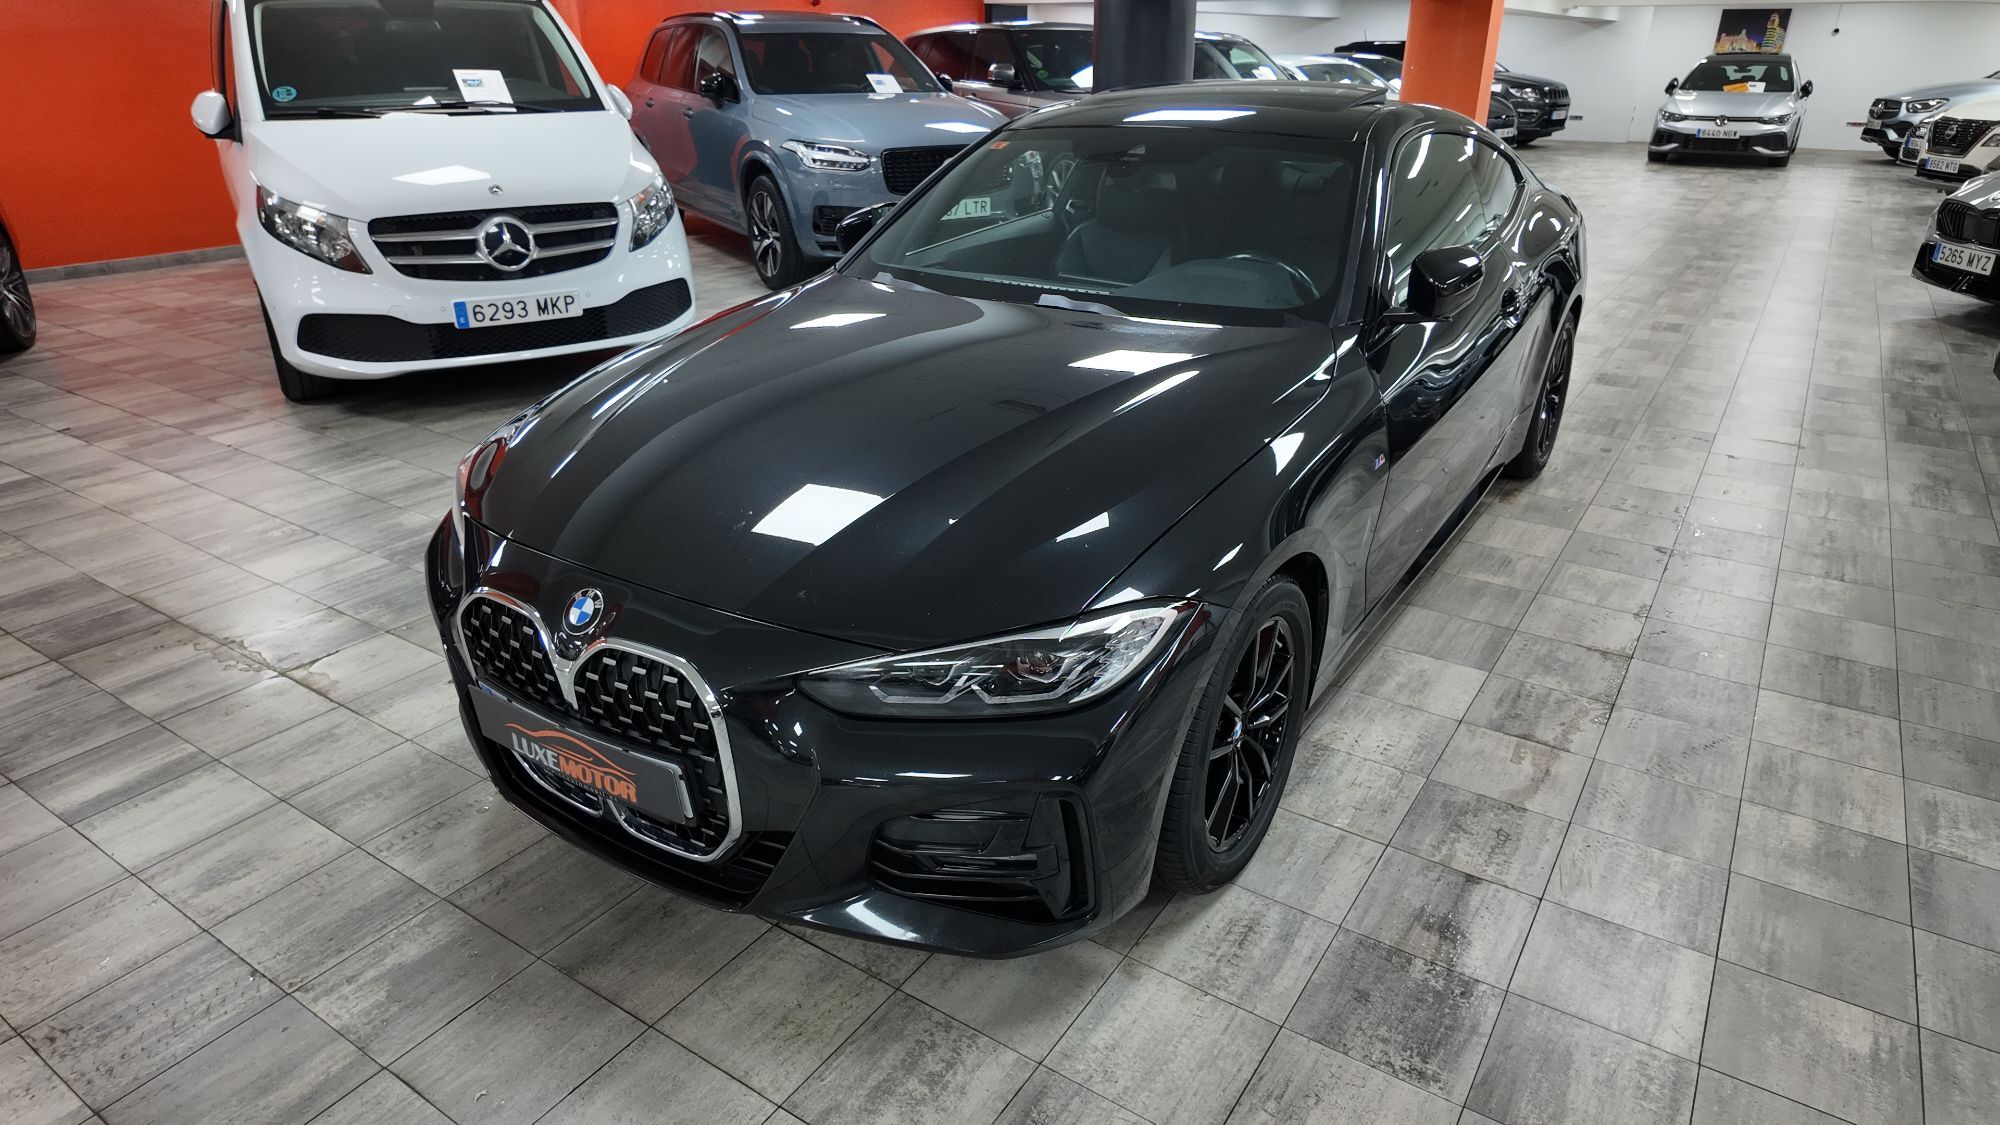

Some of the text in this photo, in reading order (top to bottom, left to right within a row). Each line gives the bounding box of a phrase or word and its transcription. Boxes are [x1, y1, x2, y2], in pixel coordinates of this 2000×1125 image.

[964, 200, 988, 216] LTR
[1939, 245, 1992, 272] 5265 MYZ
[472, 294, 575, 323] 6293 MKP
[574, 589, 602, 609] BMW
